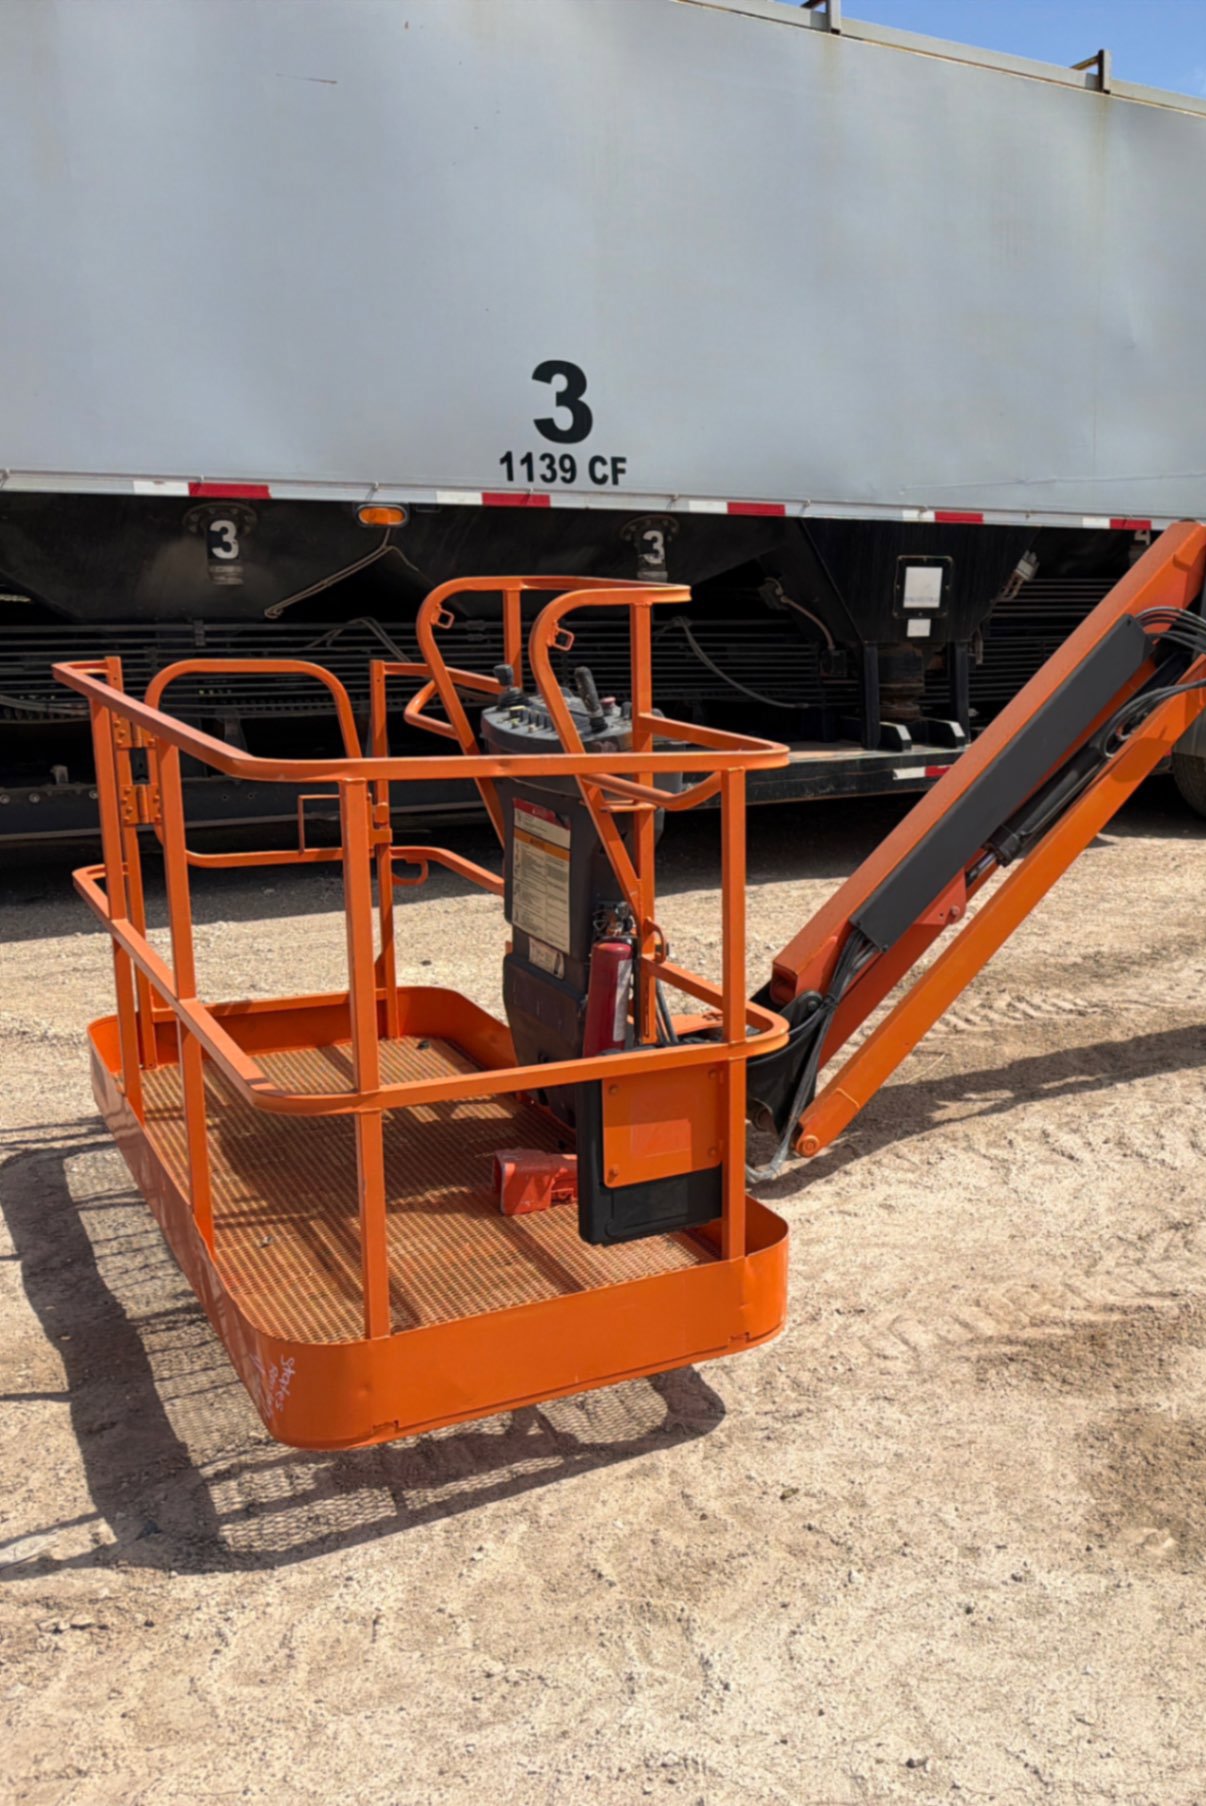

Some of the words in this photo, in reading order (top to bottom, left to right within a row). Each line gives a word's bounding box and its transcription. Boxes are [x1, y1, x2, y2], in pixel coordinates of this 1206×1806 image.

[531, 359, 593, 444] 3
[499, 450, 577, 484] 1139
[588, 455, 627, 486] CF
[209, 520, 240, 559] 3
[642, 530, 665, 565] 3
